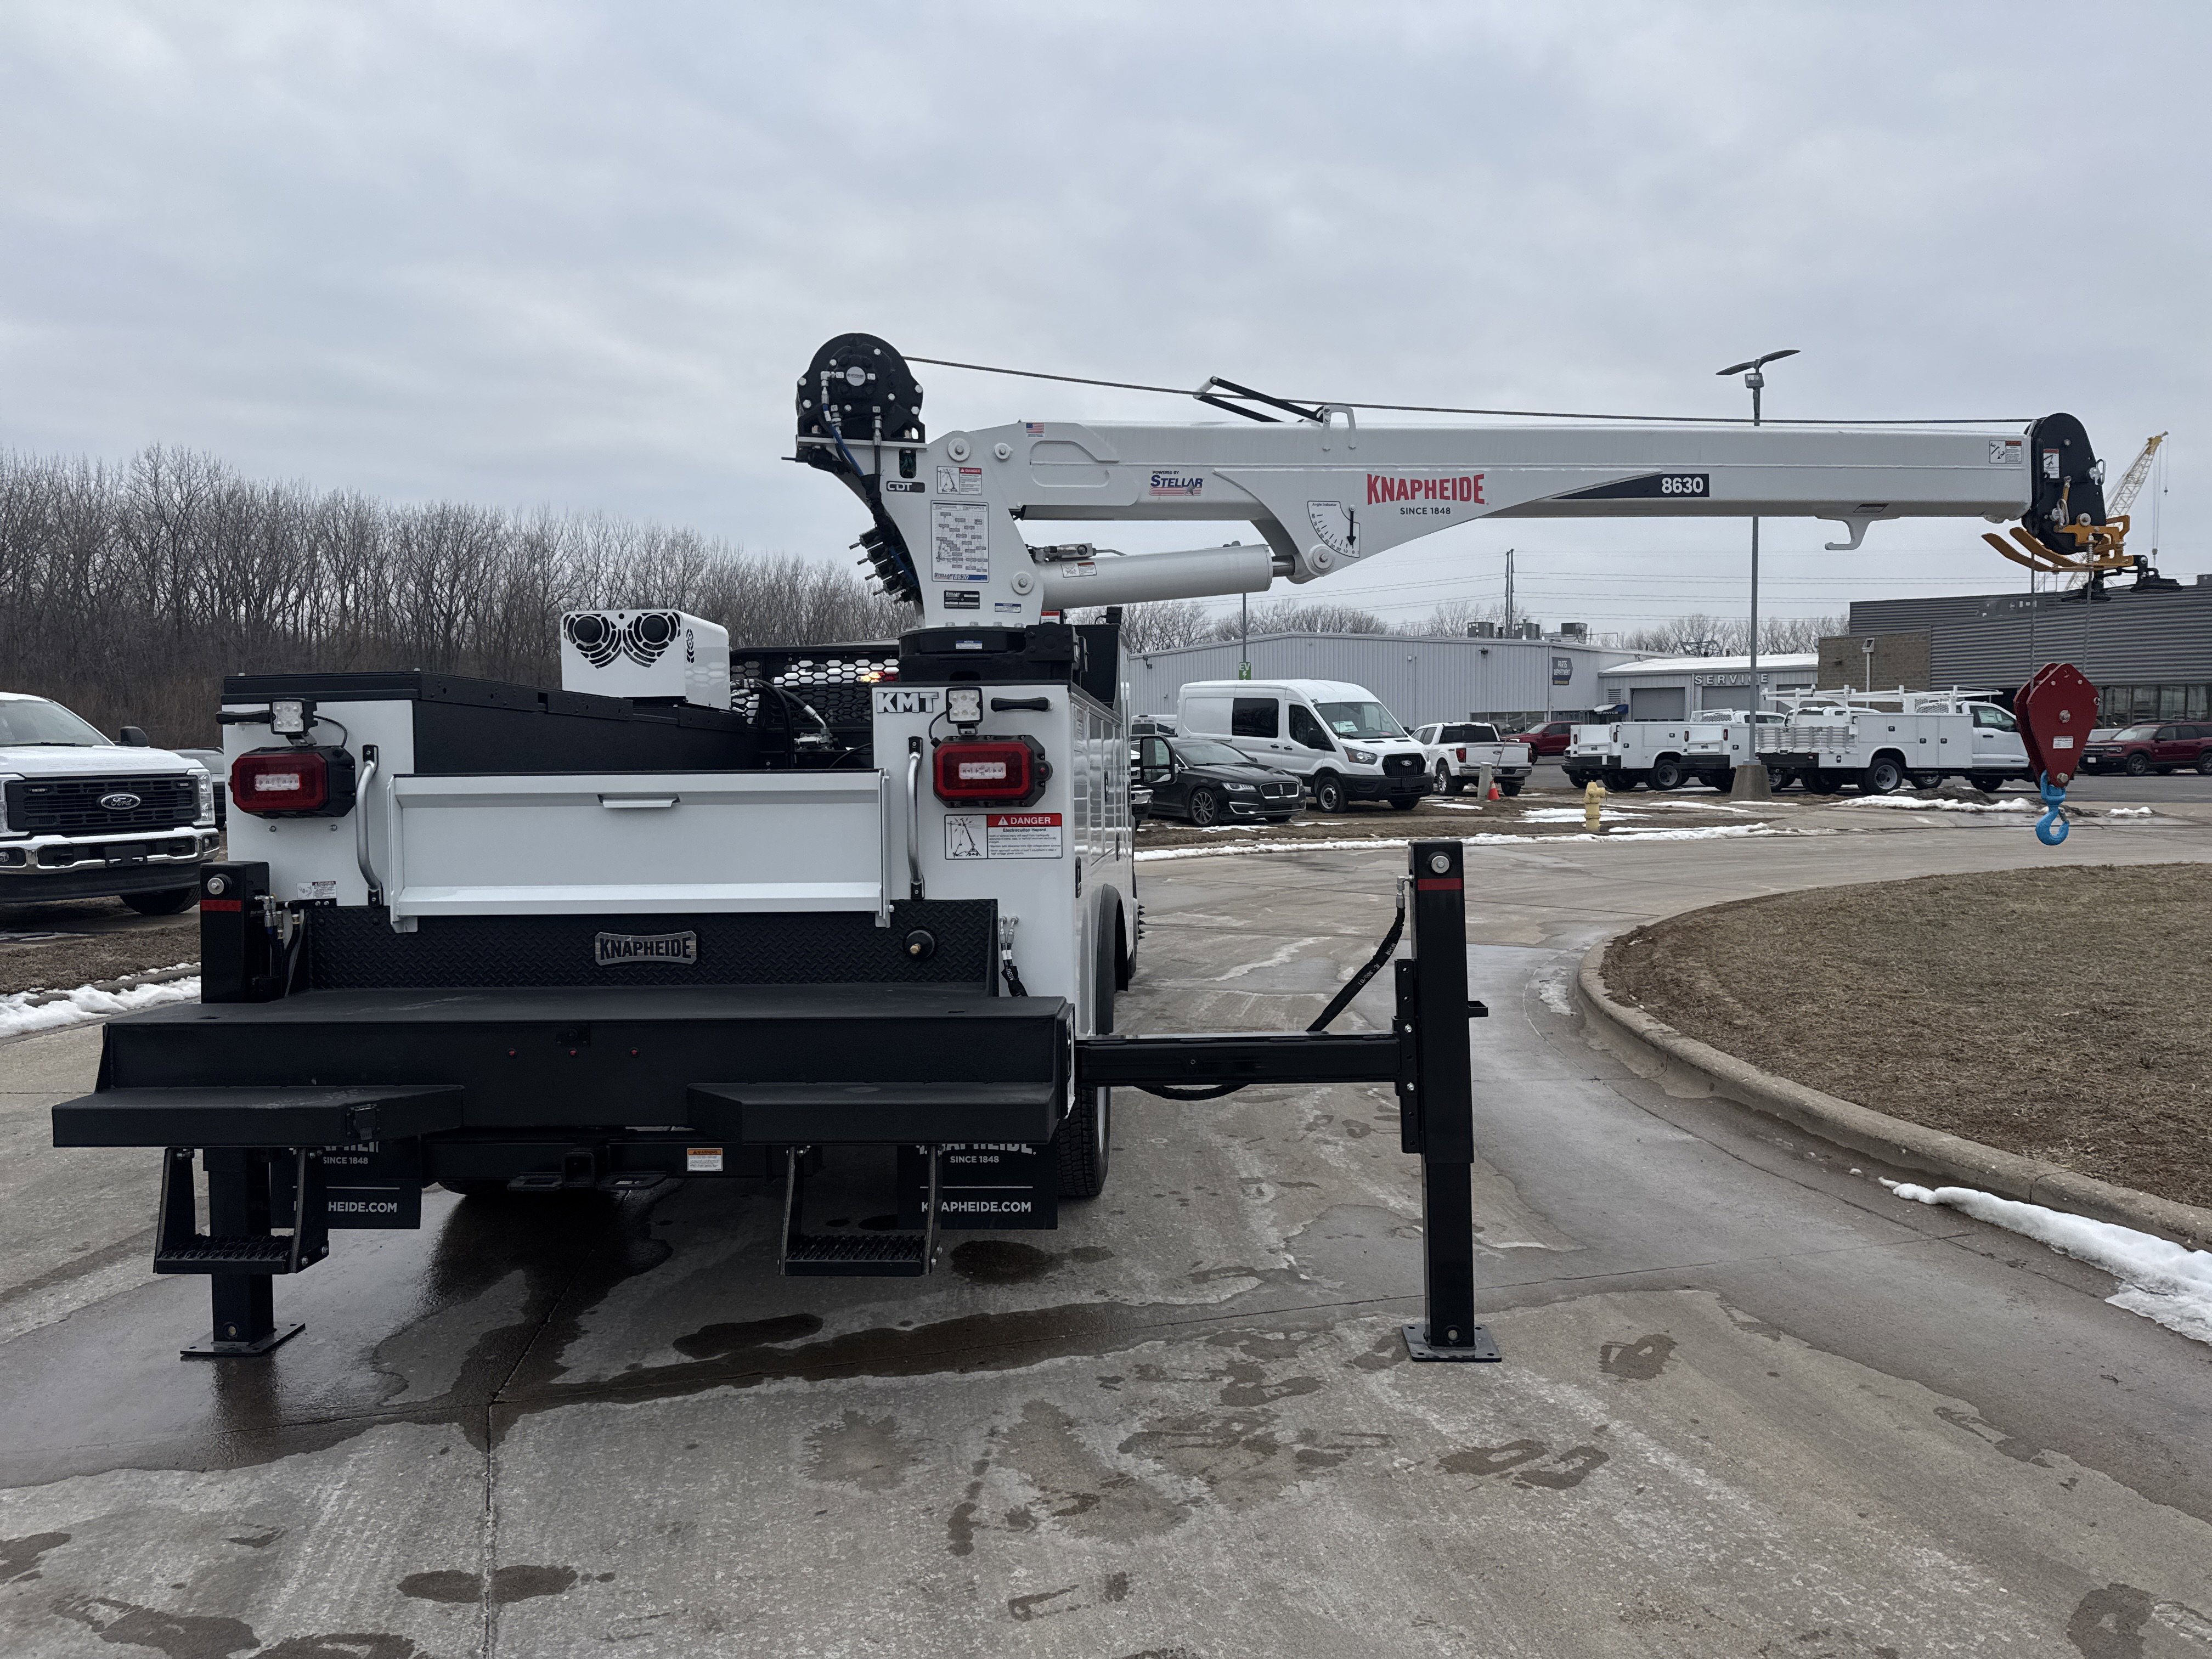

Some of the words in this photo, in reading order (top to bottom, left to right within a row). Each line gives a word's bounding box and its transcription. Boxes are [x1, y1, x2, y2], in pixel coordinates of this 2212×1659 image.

[1150, 475, 1203, 487] STELLAR
[1661, 477, 1703, 494] 8630
[887, 482, 913, 492] CDT
[1367, 473, 1485, 505] KNAPHEIDE
[1400, 507, 1427, 515] SINCE
[1239, 663, 1250, 671] EV
[877, 692, 939, 713] KMT
[110, 797, 132, 807] Ford
[1010, 816, 1051, 825] DANGER
[600, 936, 692, 961] KNAPHEIDE
[349, 1156, 369, 1165] 1848
[950, 1155, 977, 1164] SINCE
[979, 1155, 1000, 1164] 1848
[921, 1201, 1031, 1212] KAPHEIDE.COM
